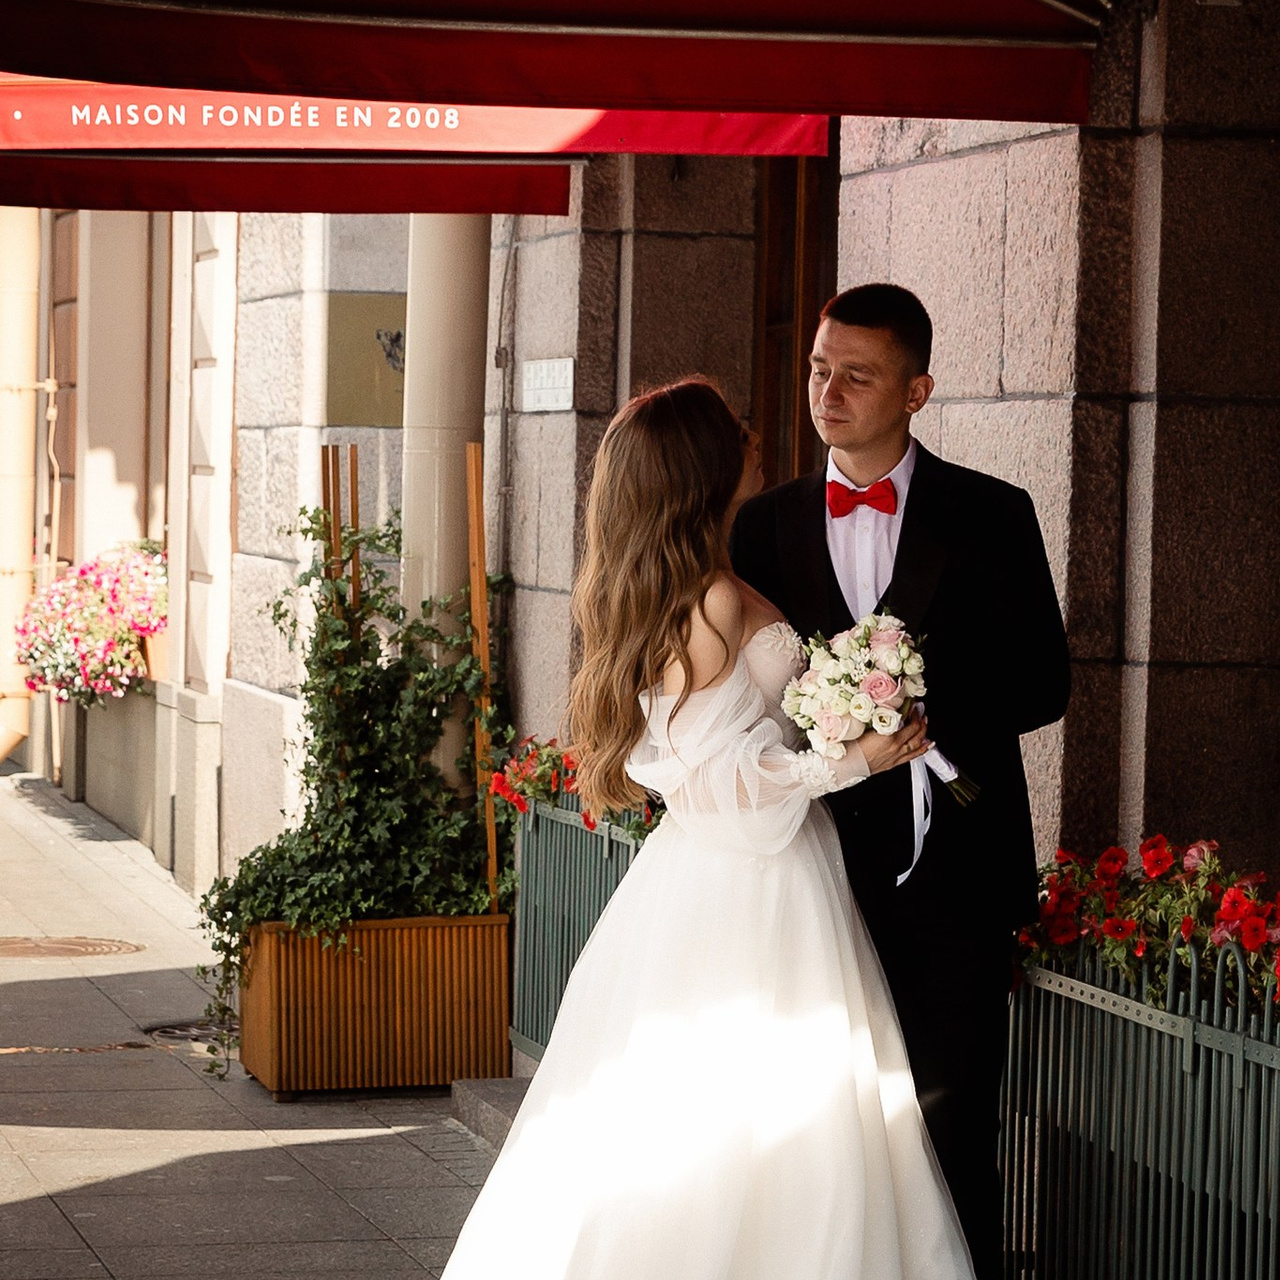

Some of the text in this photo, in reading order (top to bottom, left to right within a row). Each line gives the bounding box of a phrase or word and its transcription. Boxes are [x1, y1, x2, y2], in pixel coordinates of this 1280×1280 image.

[71, 101, 460, 129] MAISON FONDÉE EN 2008
